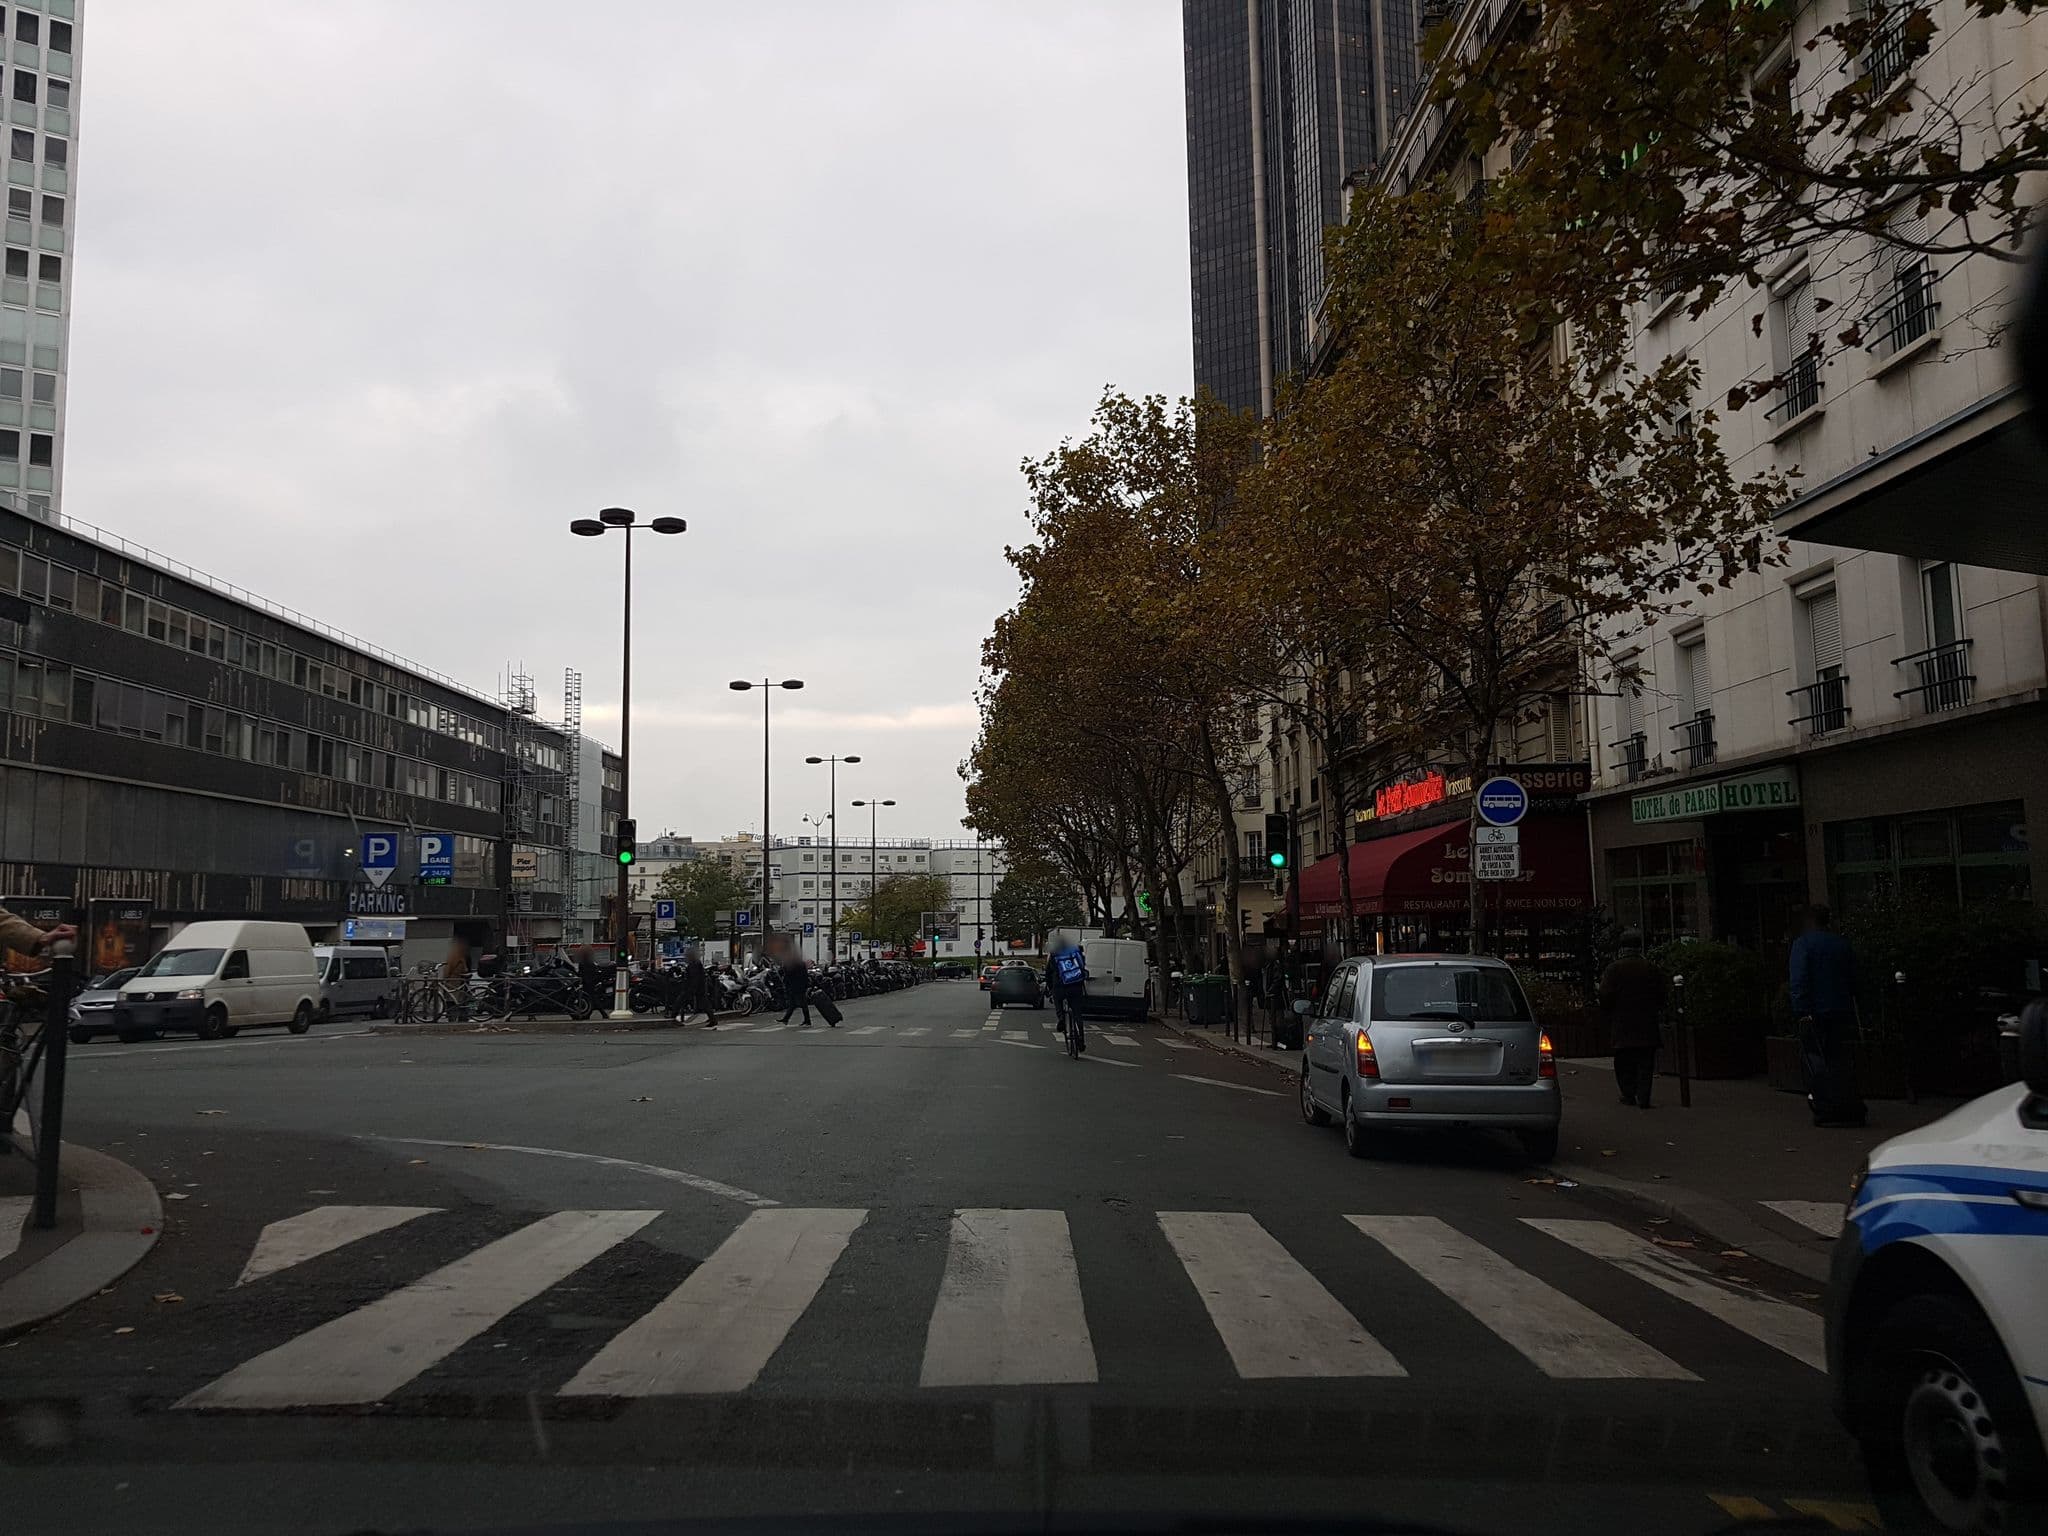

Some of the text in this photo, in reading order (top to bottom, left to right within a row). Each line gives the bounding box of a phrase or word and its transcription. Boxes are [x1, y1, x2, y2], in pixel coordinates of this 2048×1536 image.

[1488, 769, 1584, 789] sserie
[1634, 786, 1718, 821] HOTEL de PARIS
[1723, 781, 1797, 807] HOTEL
[368, 838, 391, 863] P
[421, 837, 442, 863] P
[1443, 843, 1469, 860] Le
[349, 892, 405, 913] PARKING
[661, 904, 670, 917] P
[1404, 900, 1462, 910] RESTAURANT
[1536, 898, 1558, 908] NON
[1559, 898, 1583, 908] STOP
[740, 914, 747, 924] P
